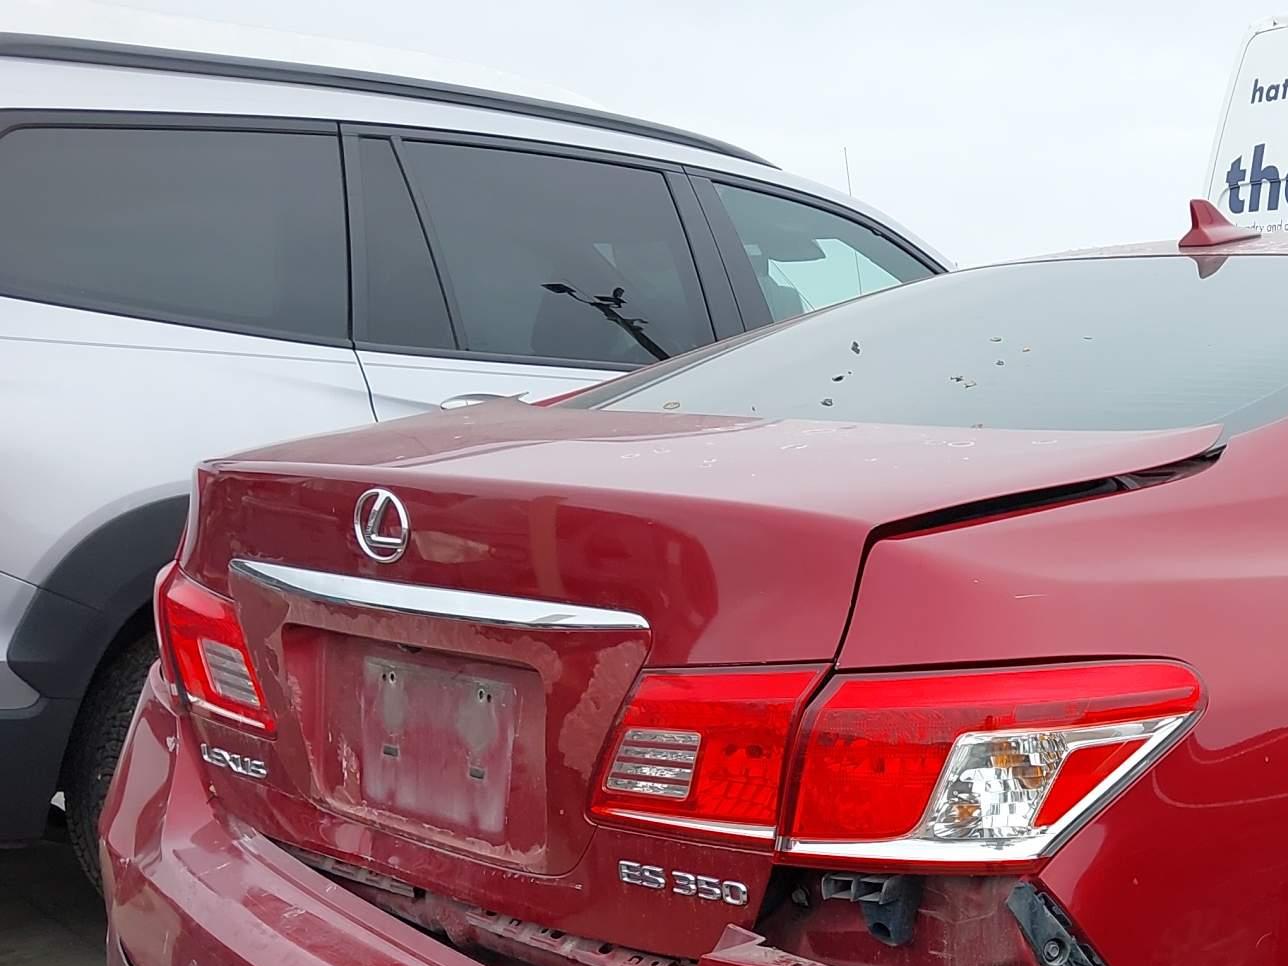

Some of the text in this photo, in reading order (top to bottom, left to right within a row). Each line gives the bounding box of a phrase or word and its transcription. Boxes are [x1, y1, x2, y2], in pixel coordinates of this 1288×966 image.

[1266, 218, 1283, 232] and
[200, 743, 267, 778] LEXUS
[619, 860, 749, 906] ES 350
